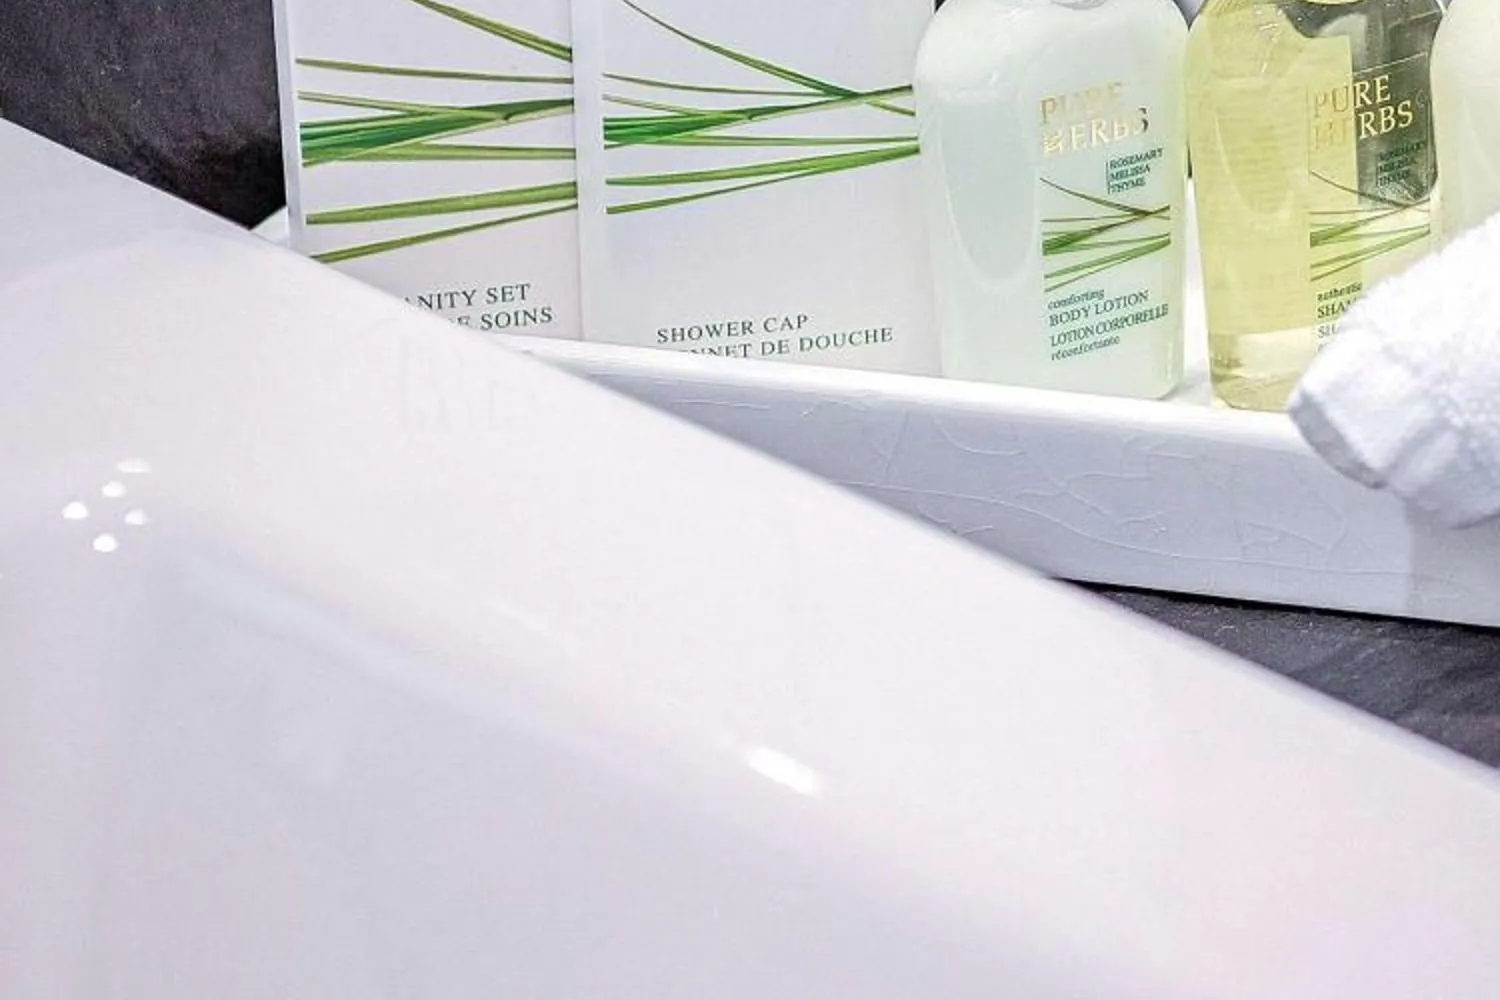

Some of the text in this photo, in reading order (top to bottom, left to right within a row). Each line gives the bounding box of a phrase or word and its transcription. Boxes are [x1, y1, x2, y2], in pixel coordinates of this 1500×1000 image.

[1314, 74, 1392, 118] PURE
[1109, 148, 1164, 169] ROSEMARY
[485, 283, 530, 305] SET
[479, 307, 553, 331] SOINS
[1049, 289, 1149, 327] BODY LOTION
[656, 313, 808, 344] SHOWER CAP
[761, 339, 790, 357] DE
[800, 327, 893, 352] DOUCHE
[1050, 325, 1095, 347] LOTION
